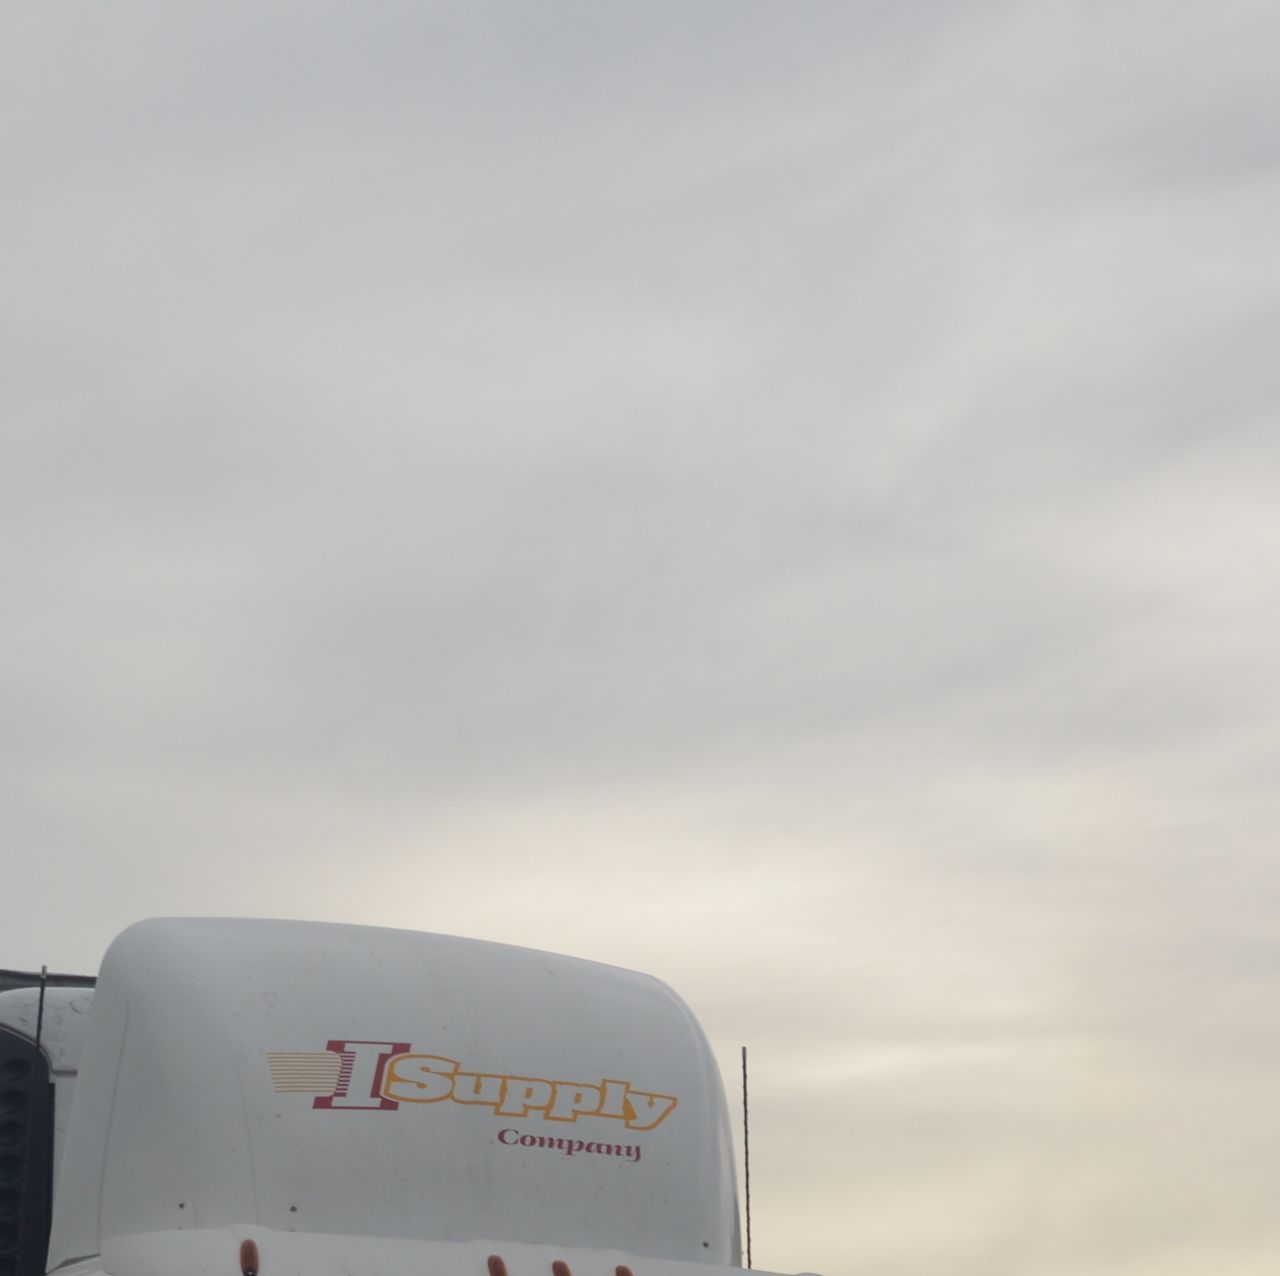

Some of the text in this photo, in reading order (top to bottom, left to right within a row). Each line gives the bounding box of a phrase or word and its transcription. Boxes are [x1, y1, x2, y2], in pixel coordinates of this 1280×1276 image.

[312, 1040, 678, 1131] I Supply
[497, 1128, 642, 1162] Company
